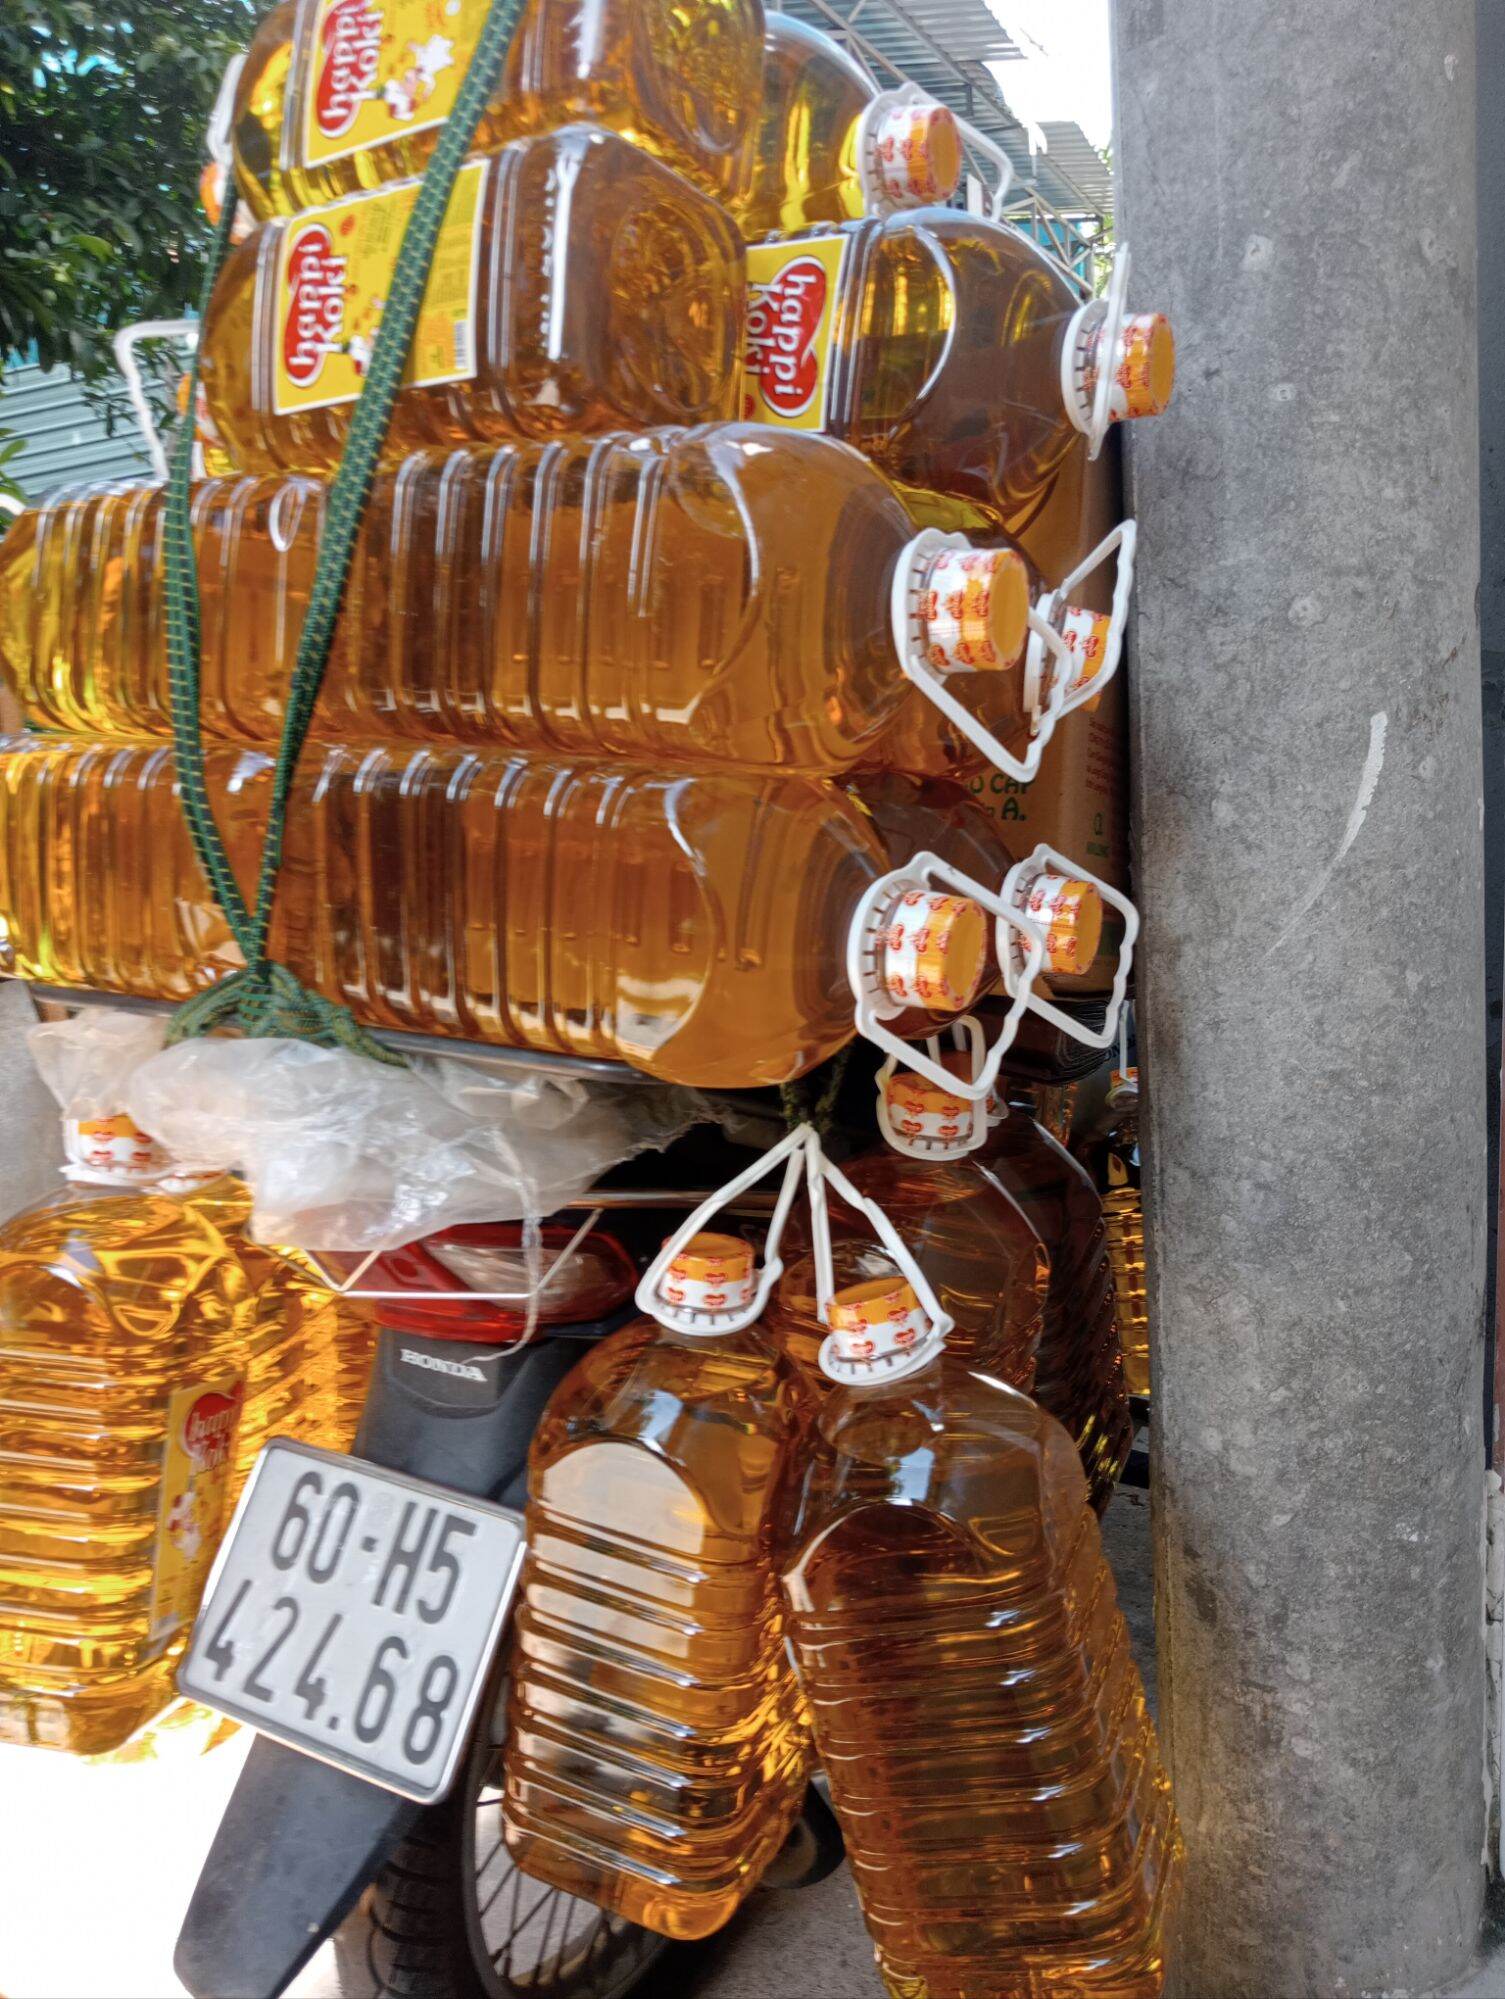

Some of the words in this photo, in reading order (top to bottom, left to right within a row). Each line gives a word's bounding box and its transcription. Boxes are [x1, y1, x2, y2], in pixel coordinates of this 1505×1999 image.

[288, 243, 324, 366] happi
[769, 274, 817, 396] happi
[400, 1348, 489, 1382] HONDA
[271, 1470, 477, 1625] 60-H5
[204, 1578, 459, 1766] 424.68
